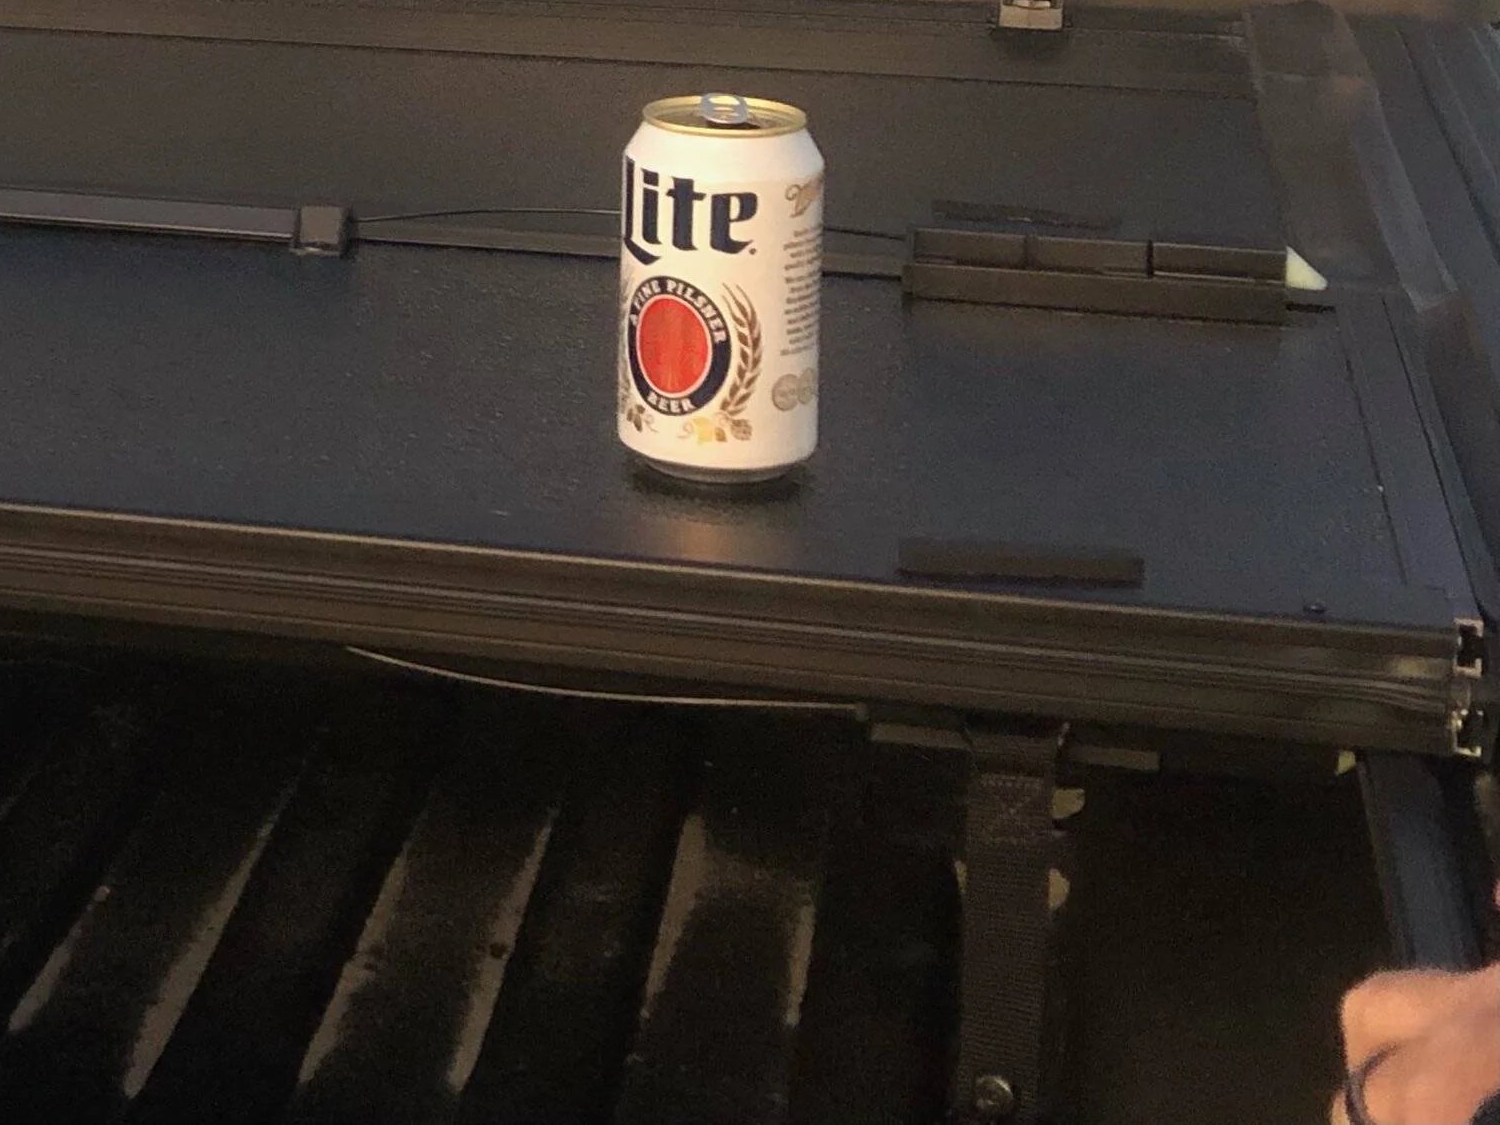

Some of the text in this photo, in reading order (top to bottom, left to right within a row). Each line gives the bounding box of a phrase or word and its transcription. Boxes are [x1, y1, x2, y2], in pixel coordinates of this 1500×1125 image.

[623, 155, 757, 265] Lite
[634, 279, 660, 307] FINE
[666, 278, 727, 343] PILSNER
[647, 391, 696, 413] BEER
